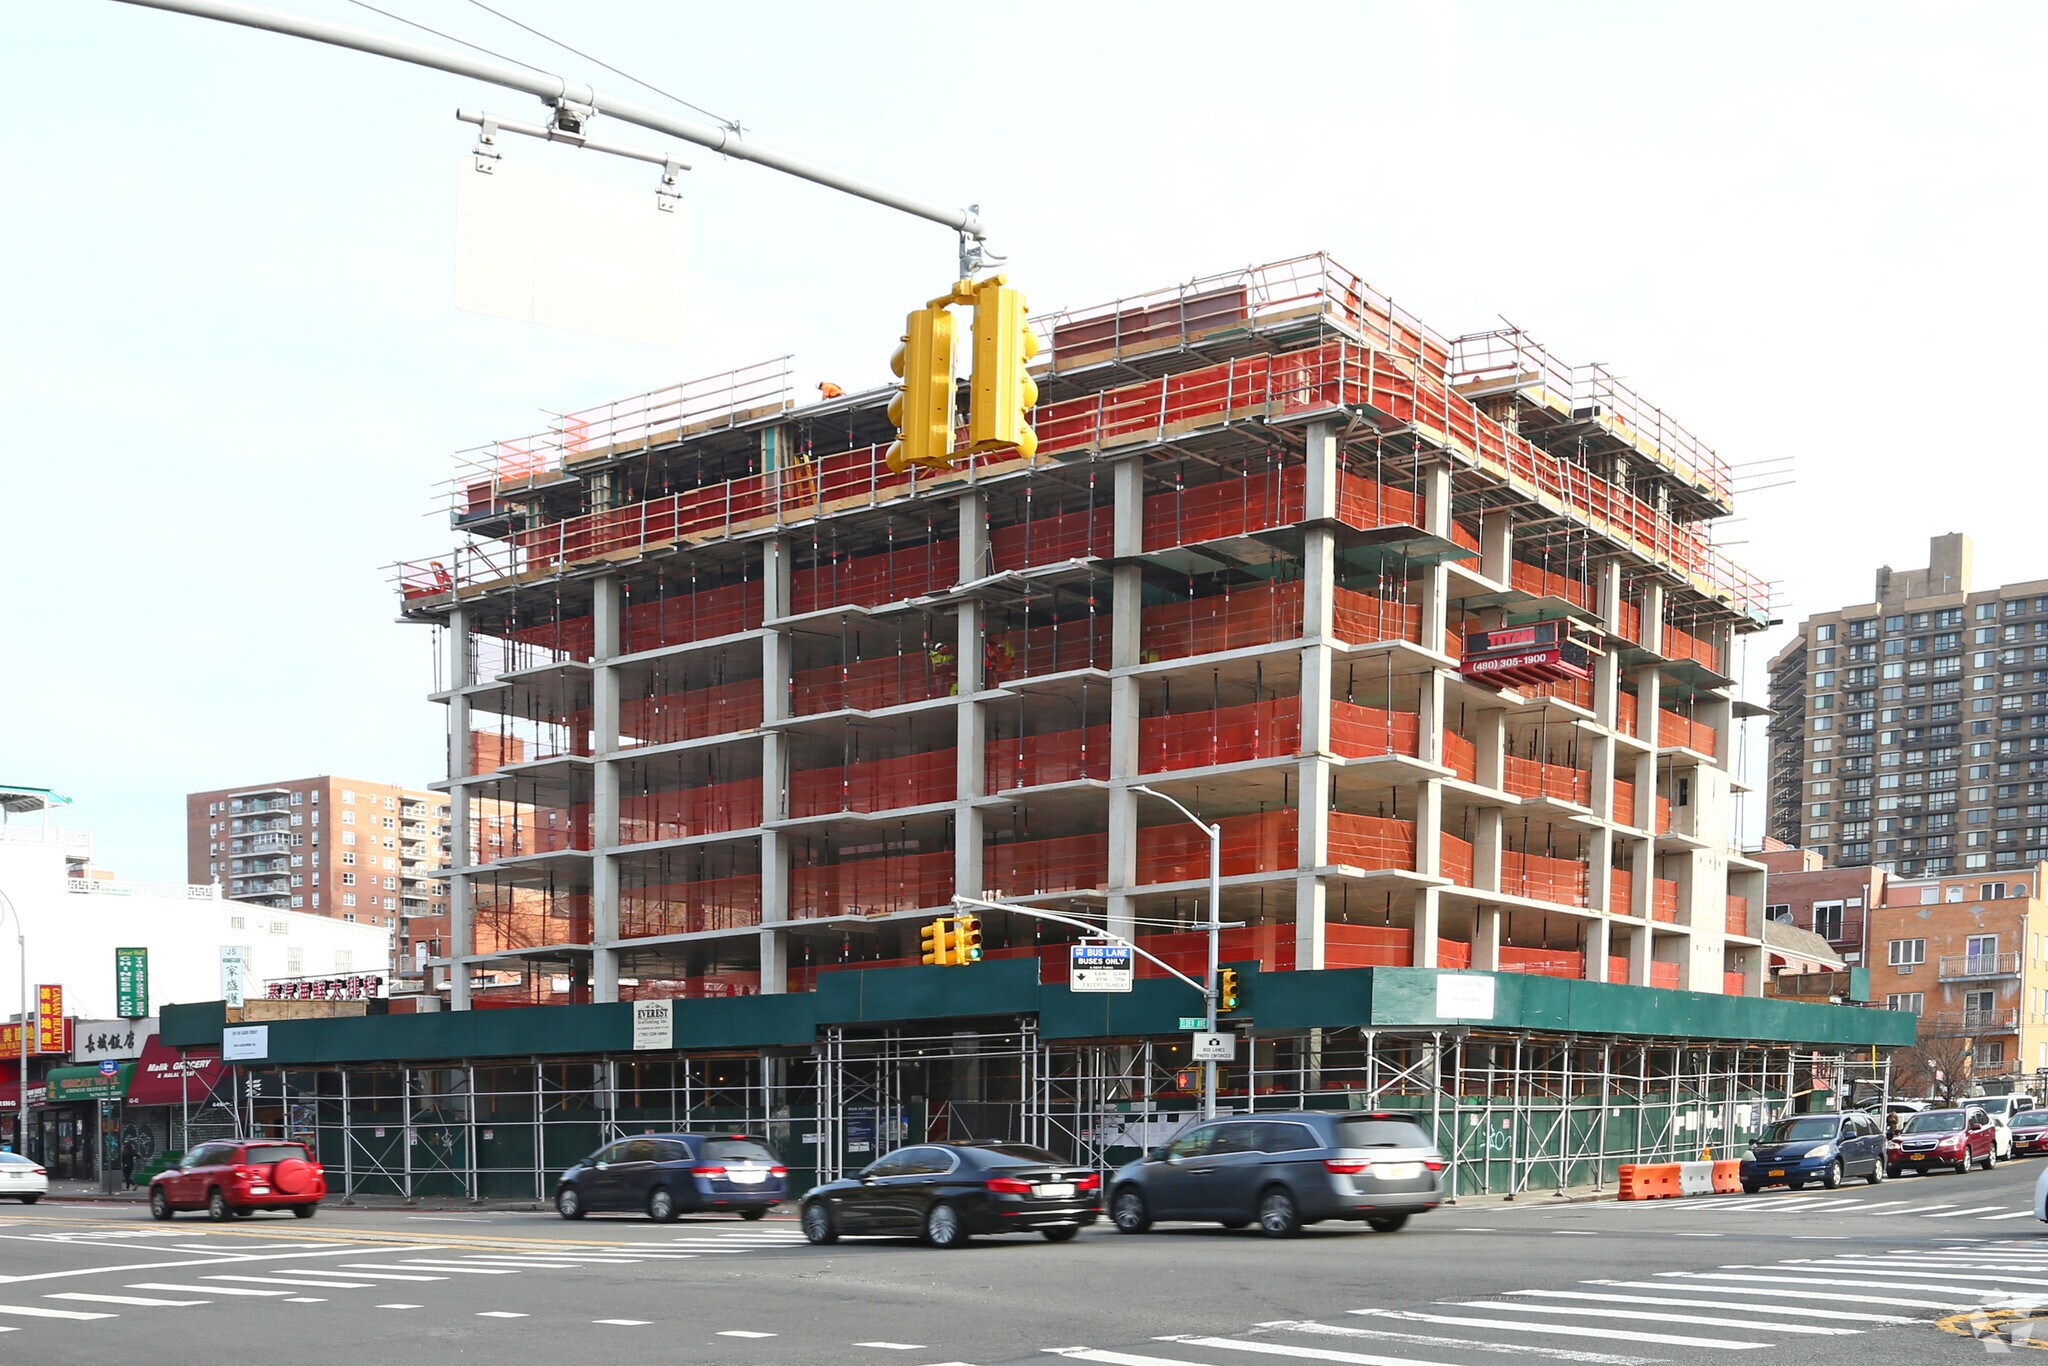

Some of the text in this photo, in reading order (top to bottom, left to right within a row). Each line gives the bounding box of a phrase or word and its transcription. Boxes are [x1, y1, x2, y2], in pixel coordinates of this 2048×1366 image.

[1488, 630, 1534, 646] TITAN
[1473, 654, 1546, 672] (480) 305-1900
[120, 956, 132, 1016] CHINESE FOOD
[52, 988, 62, 1044] CANAAN REALTY
[638, 1008, 668, 1018] EVEREST
[1180, 1019, 1194, 1028] ELDER
[147, 1063, 168, 1072] Malik
[60, 1078, 92, 1088] GREAT
